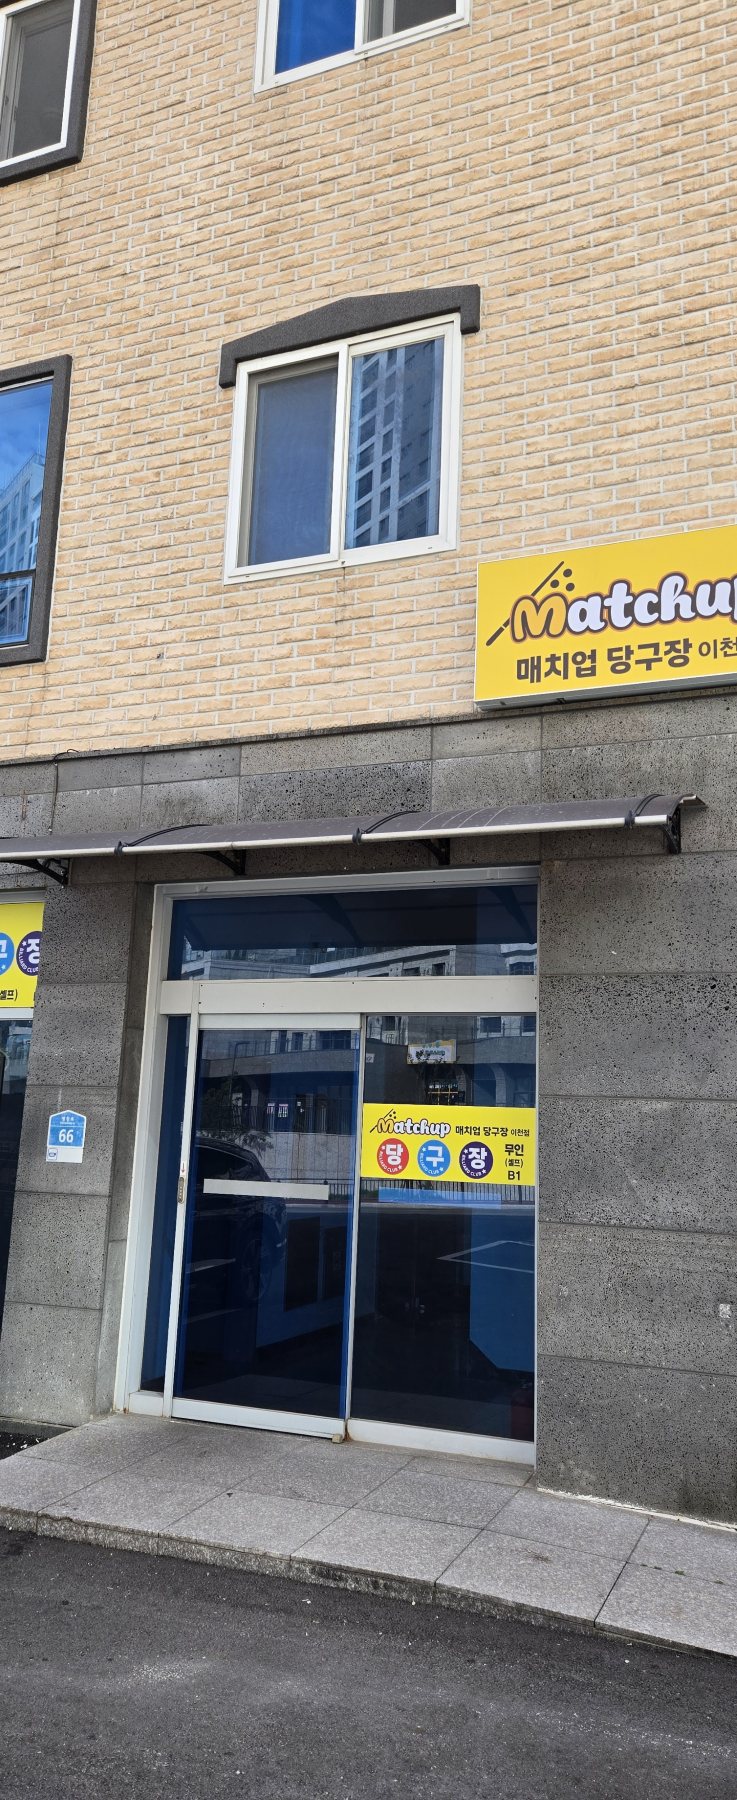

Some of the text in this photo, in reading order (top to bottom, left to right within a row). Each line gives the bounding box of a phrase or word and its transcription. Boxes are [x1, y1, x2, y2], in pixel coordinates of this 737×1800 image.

[510, 571, 737, 644] Matchu
[516, 648, 597, 684] 매치업
[606, 637, 693, 675] 당구장
[377, 1117, 451, 1138] Matchup
[455, 1125, 530, 1137] 매치업 당구장 이천점
[58, 1129, 74, 1143] 66
[385, 1143, 488, 1170] 당 구 장
[504, 1144, 524, 1156] 무인
[505, 1158, 524, 1168] (셀프)
[507, 1170, 521, 1181] B1
